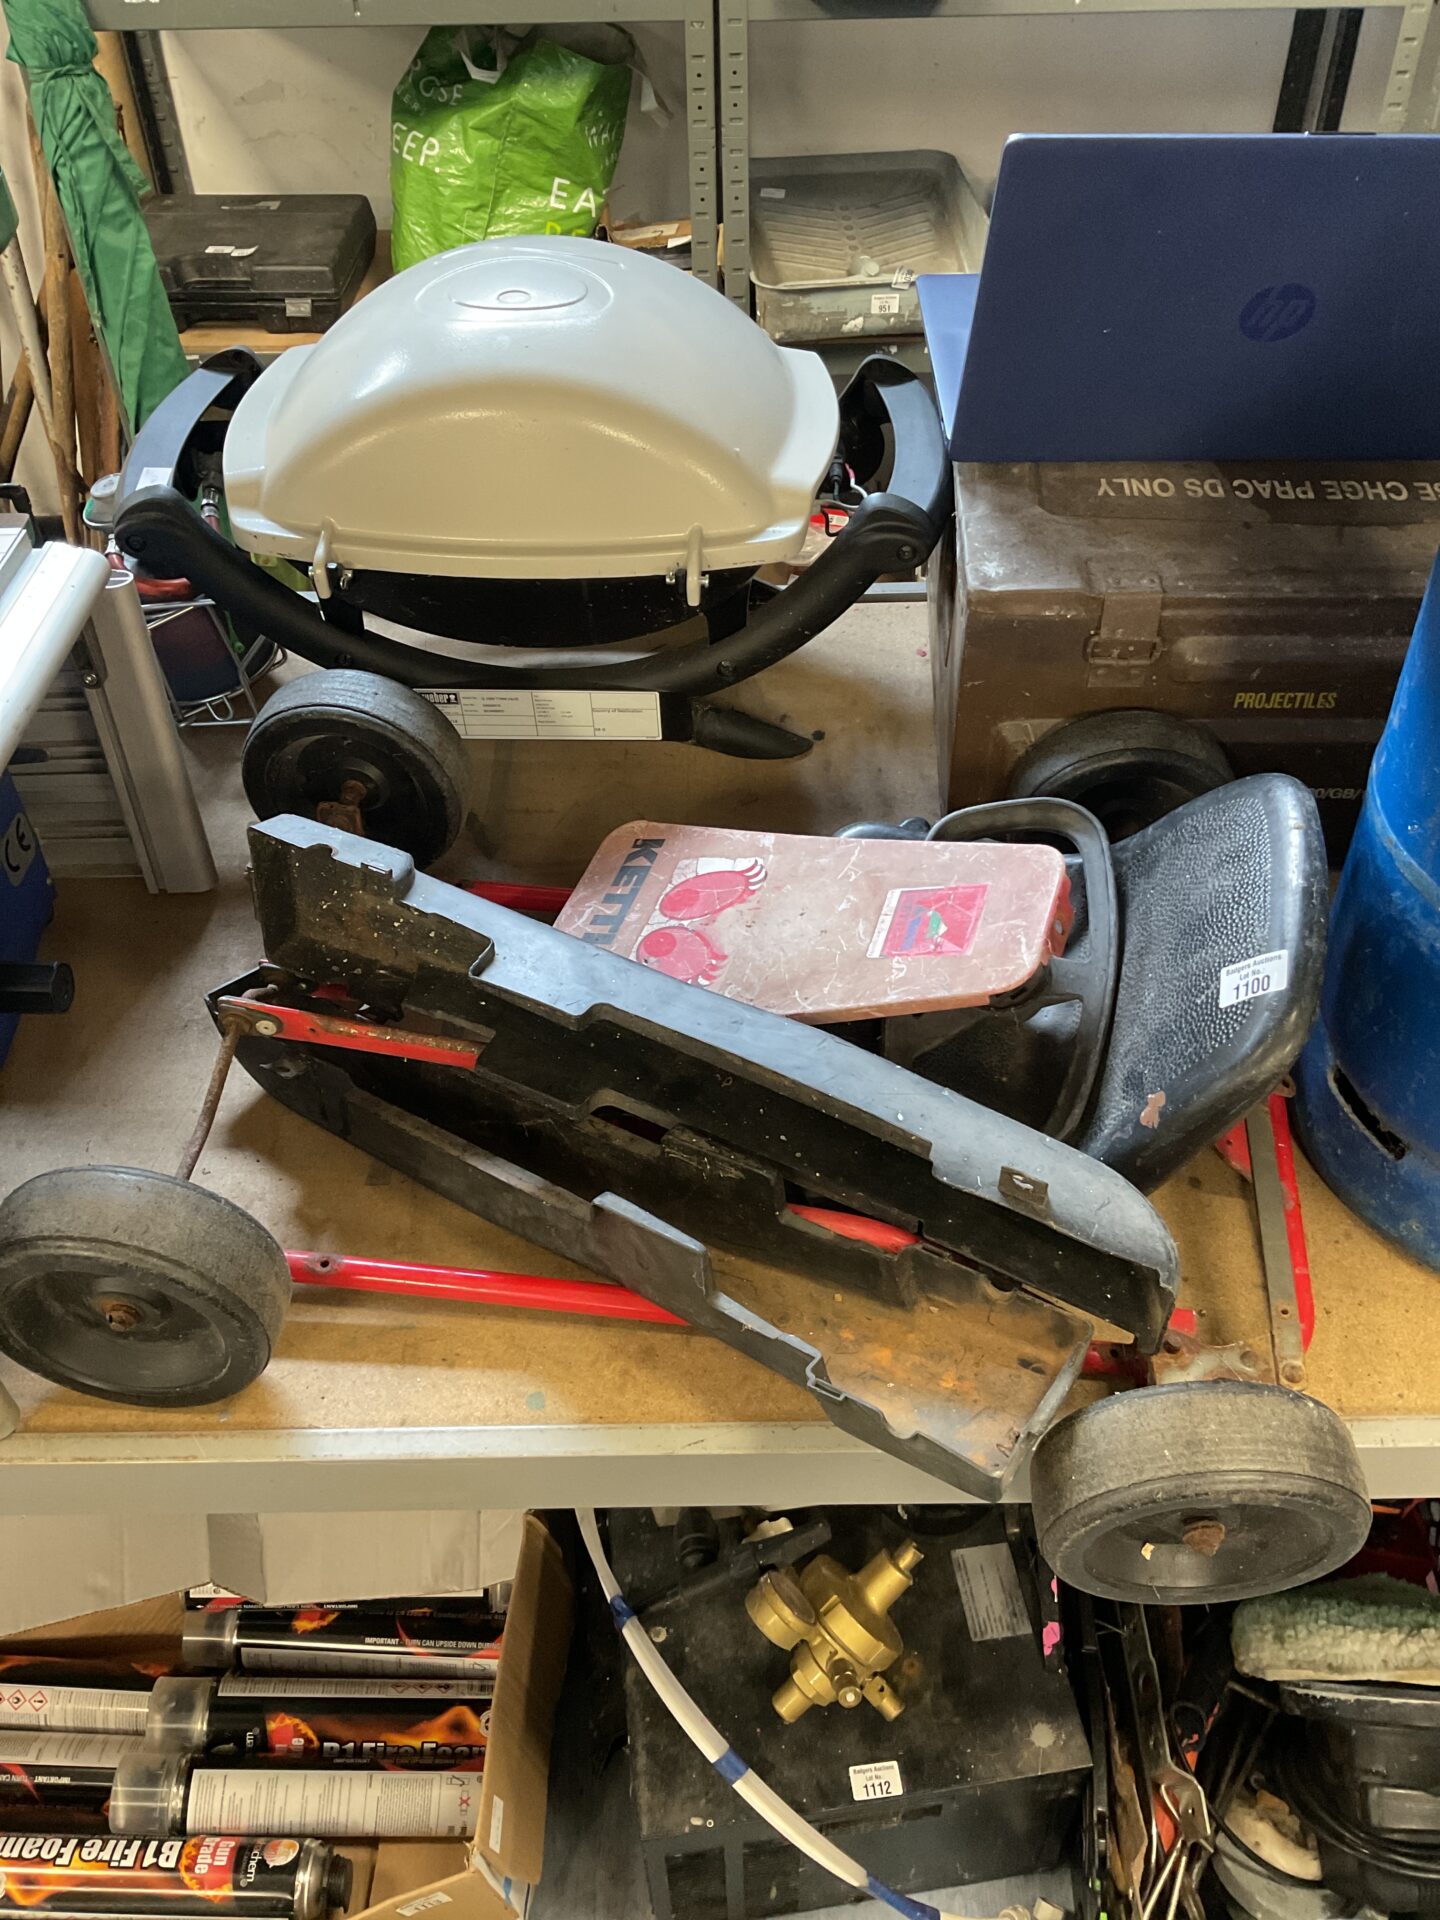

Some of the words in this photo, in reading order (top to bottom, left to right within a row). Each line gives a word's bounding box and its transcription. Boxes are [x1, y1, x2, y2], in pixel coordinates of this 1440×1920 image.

[878, 305, 891, 313] 951
[1097, 477, 1176, 498] ONLY
[1183, 478, 1225, 498] DS
[1231, 479, 1315, 500] PRAC
[1320, 480, 1409, 501] CHGE
[1233, 692, 1337, 709] PROJECTILES
[1233, 974, 1271, 1001] 1100
[364, 1637, 400, 1645] IMPORTANT
[422, 1639, 435, 1647] CAN
[435, 1640, 457, 1648] UPSIDE
[457, 1640, 478, 1649] DOWN
[34, 1775, 71, 1784] IMPORTANT
[863, 1780, 892, 1797] 1112
[81, 1839, 141, 1867] Fire
[143, 1840, 183, 1868] B1
